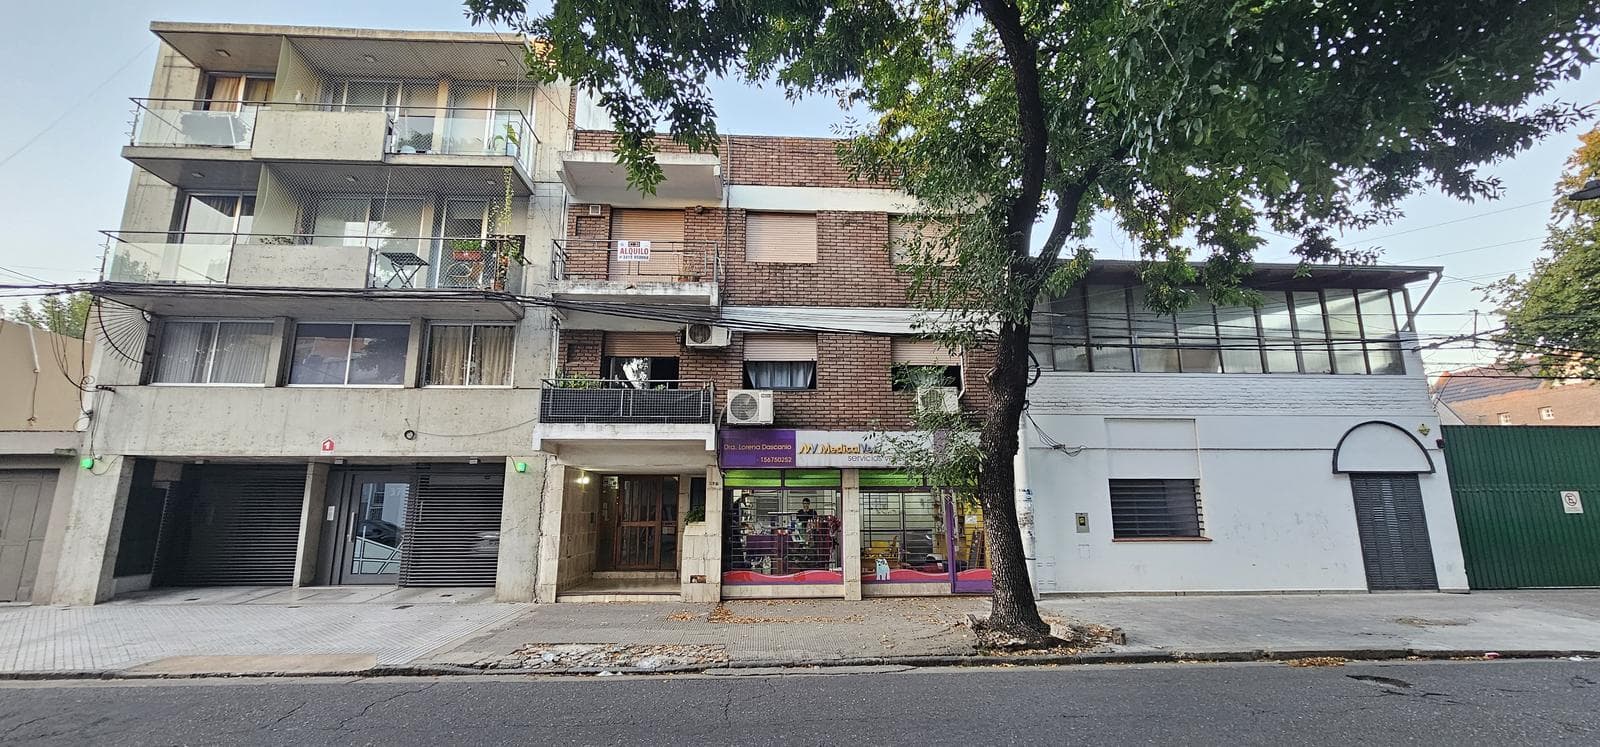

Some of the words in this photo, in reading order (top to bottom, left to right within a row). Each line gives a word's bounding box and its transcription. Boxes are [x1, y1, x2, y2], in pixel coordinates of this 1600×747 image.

[620, 247, 649, 255] ALQUILO
[723, 443, 737, 451] Dra.
[738, 443, 761, 451] Lorena
[761, 443, 792, 451] Dascanio
